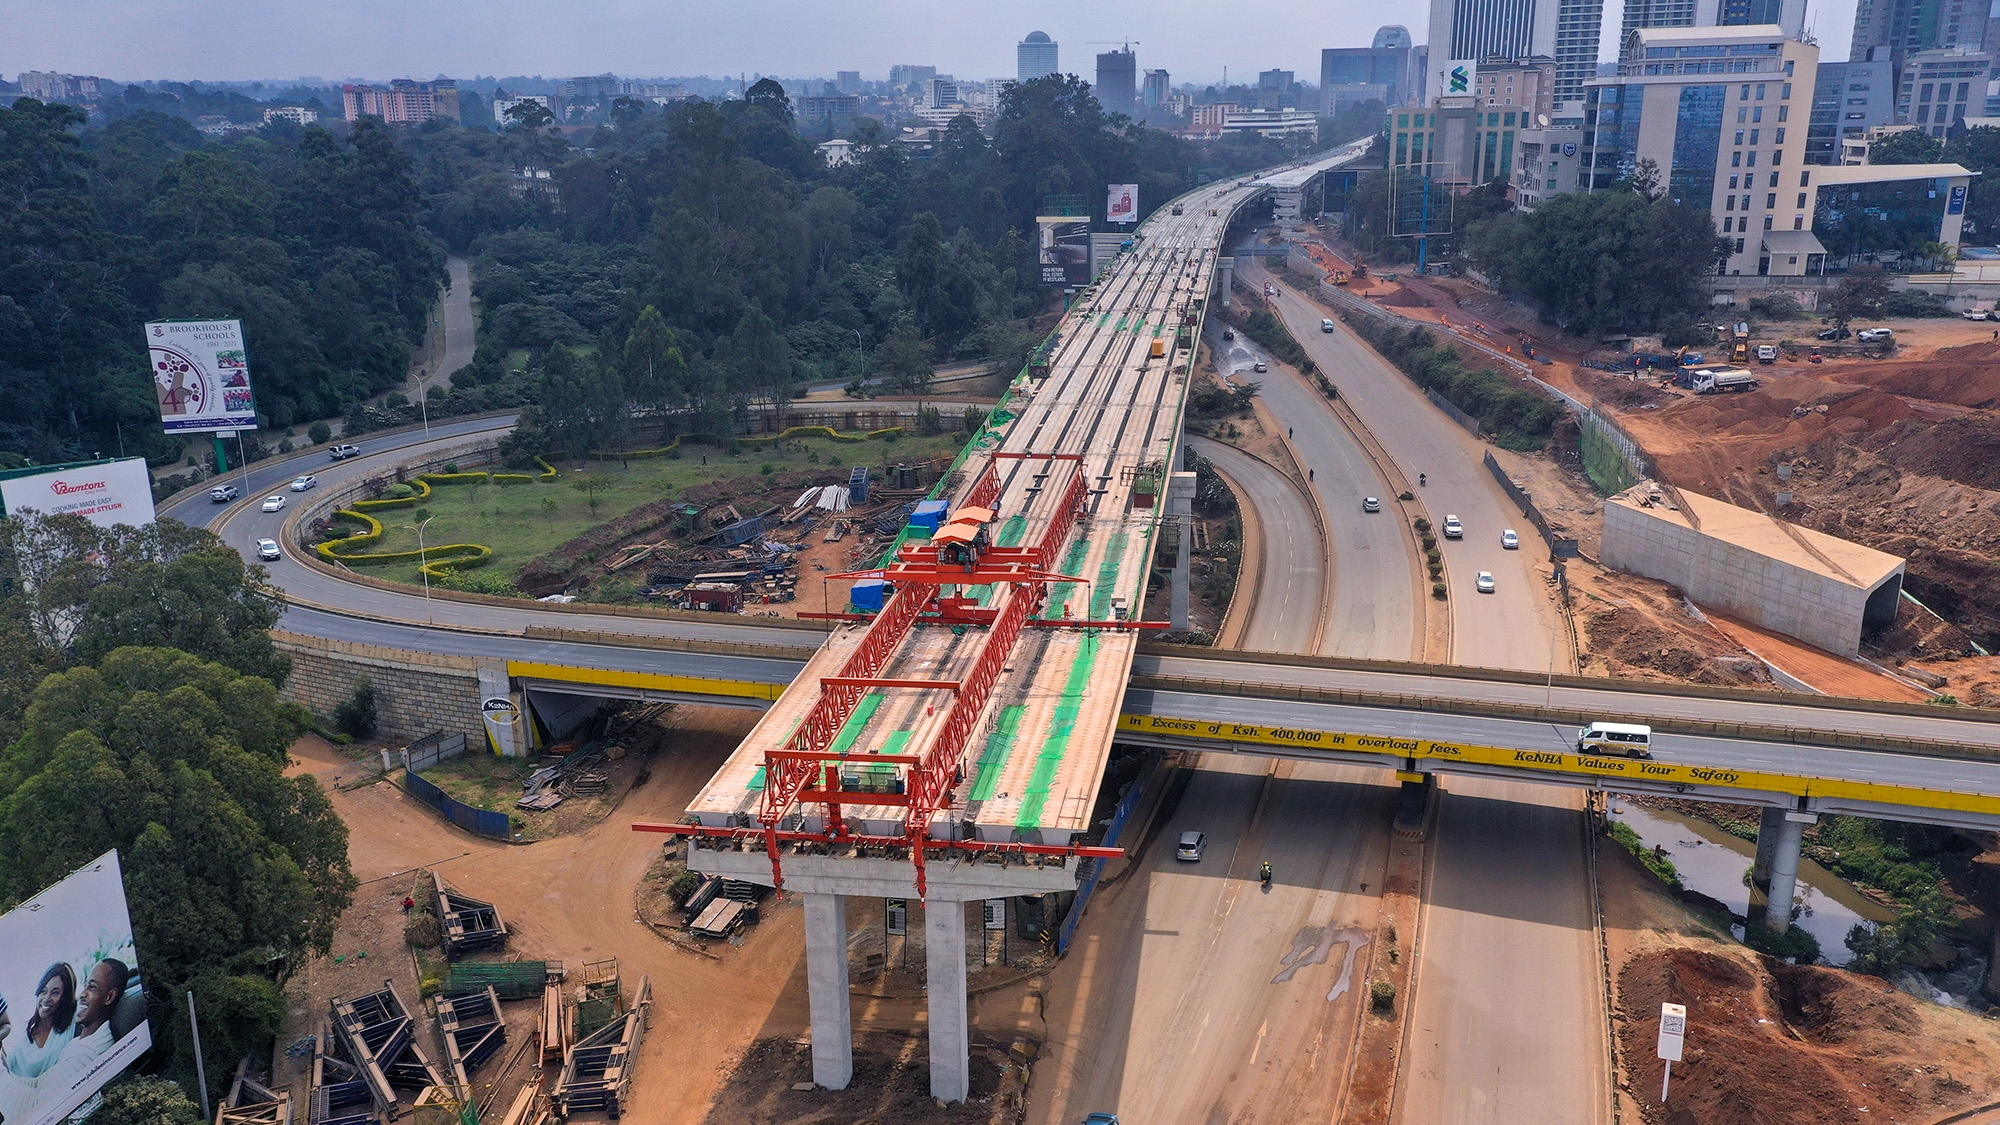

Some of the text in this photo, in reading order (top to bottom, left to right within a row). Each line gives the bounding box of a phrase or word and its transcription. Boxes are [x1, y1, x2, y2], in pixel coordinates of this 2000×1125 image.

[170, 324, 233, 332] BROOKHOUSE
[194, 332, 235, 340] SCHOOLS
[58, 481, 106, 494] Ramtons
[52, 503, 78, 513] COOKING
[97, 497, 112, 505] EASY
[77, 508, 96, 516] MADE
[97, 503, 122, 512] STYLISH
[1130, 716, 1462, 755] in Excess of Ksh. 400,000 in overload fees.
[1514, 751, 1740, 784] KeNHA Values Your Safety
[71, 1036, 137, 1090] www.jubileeinsurance.com
